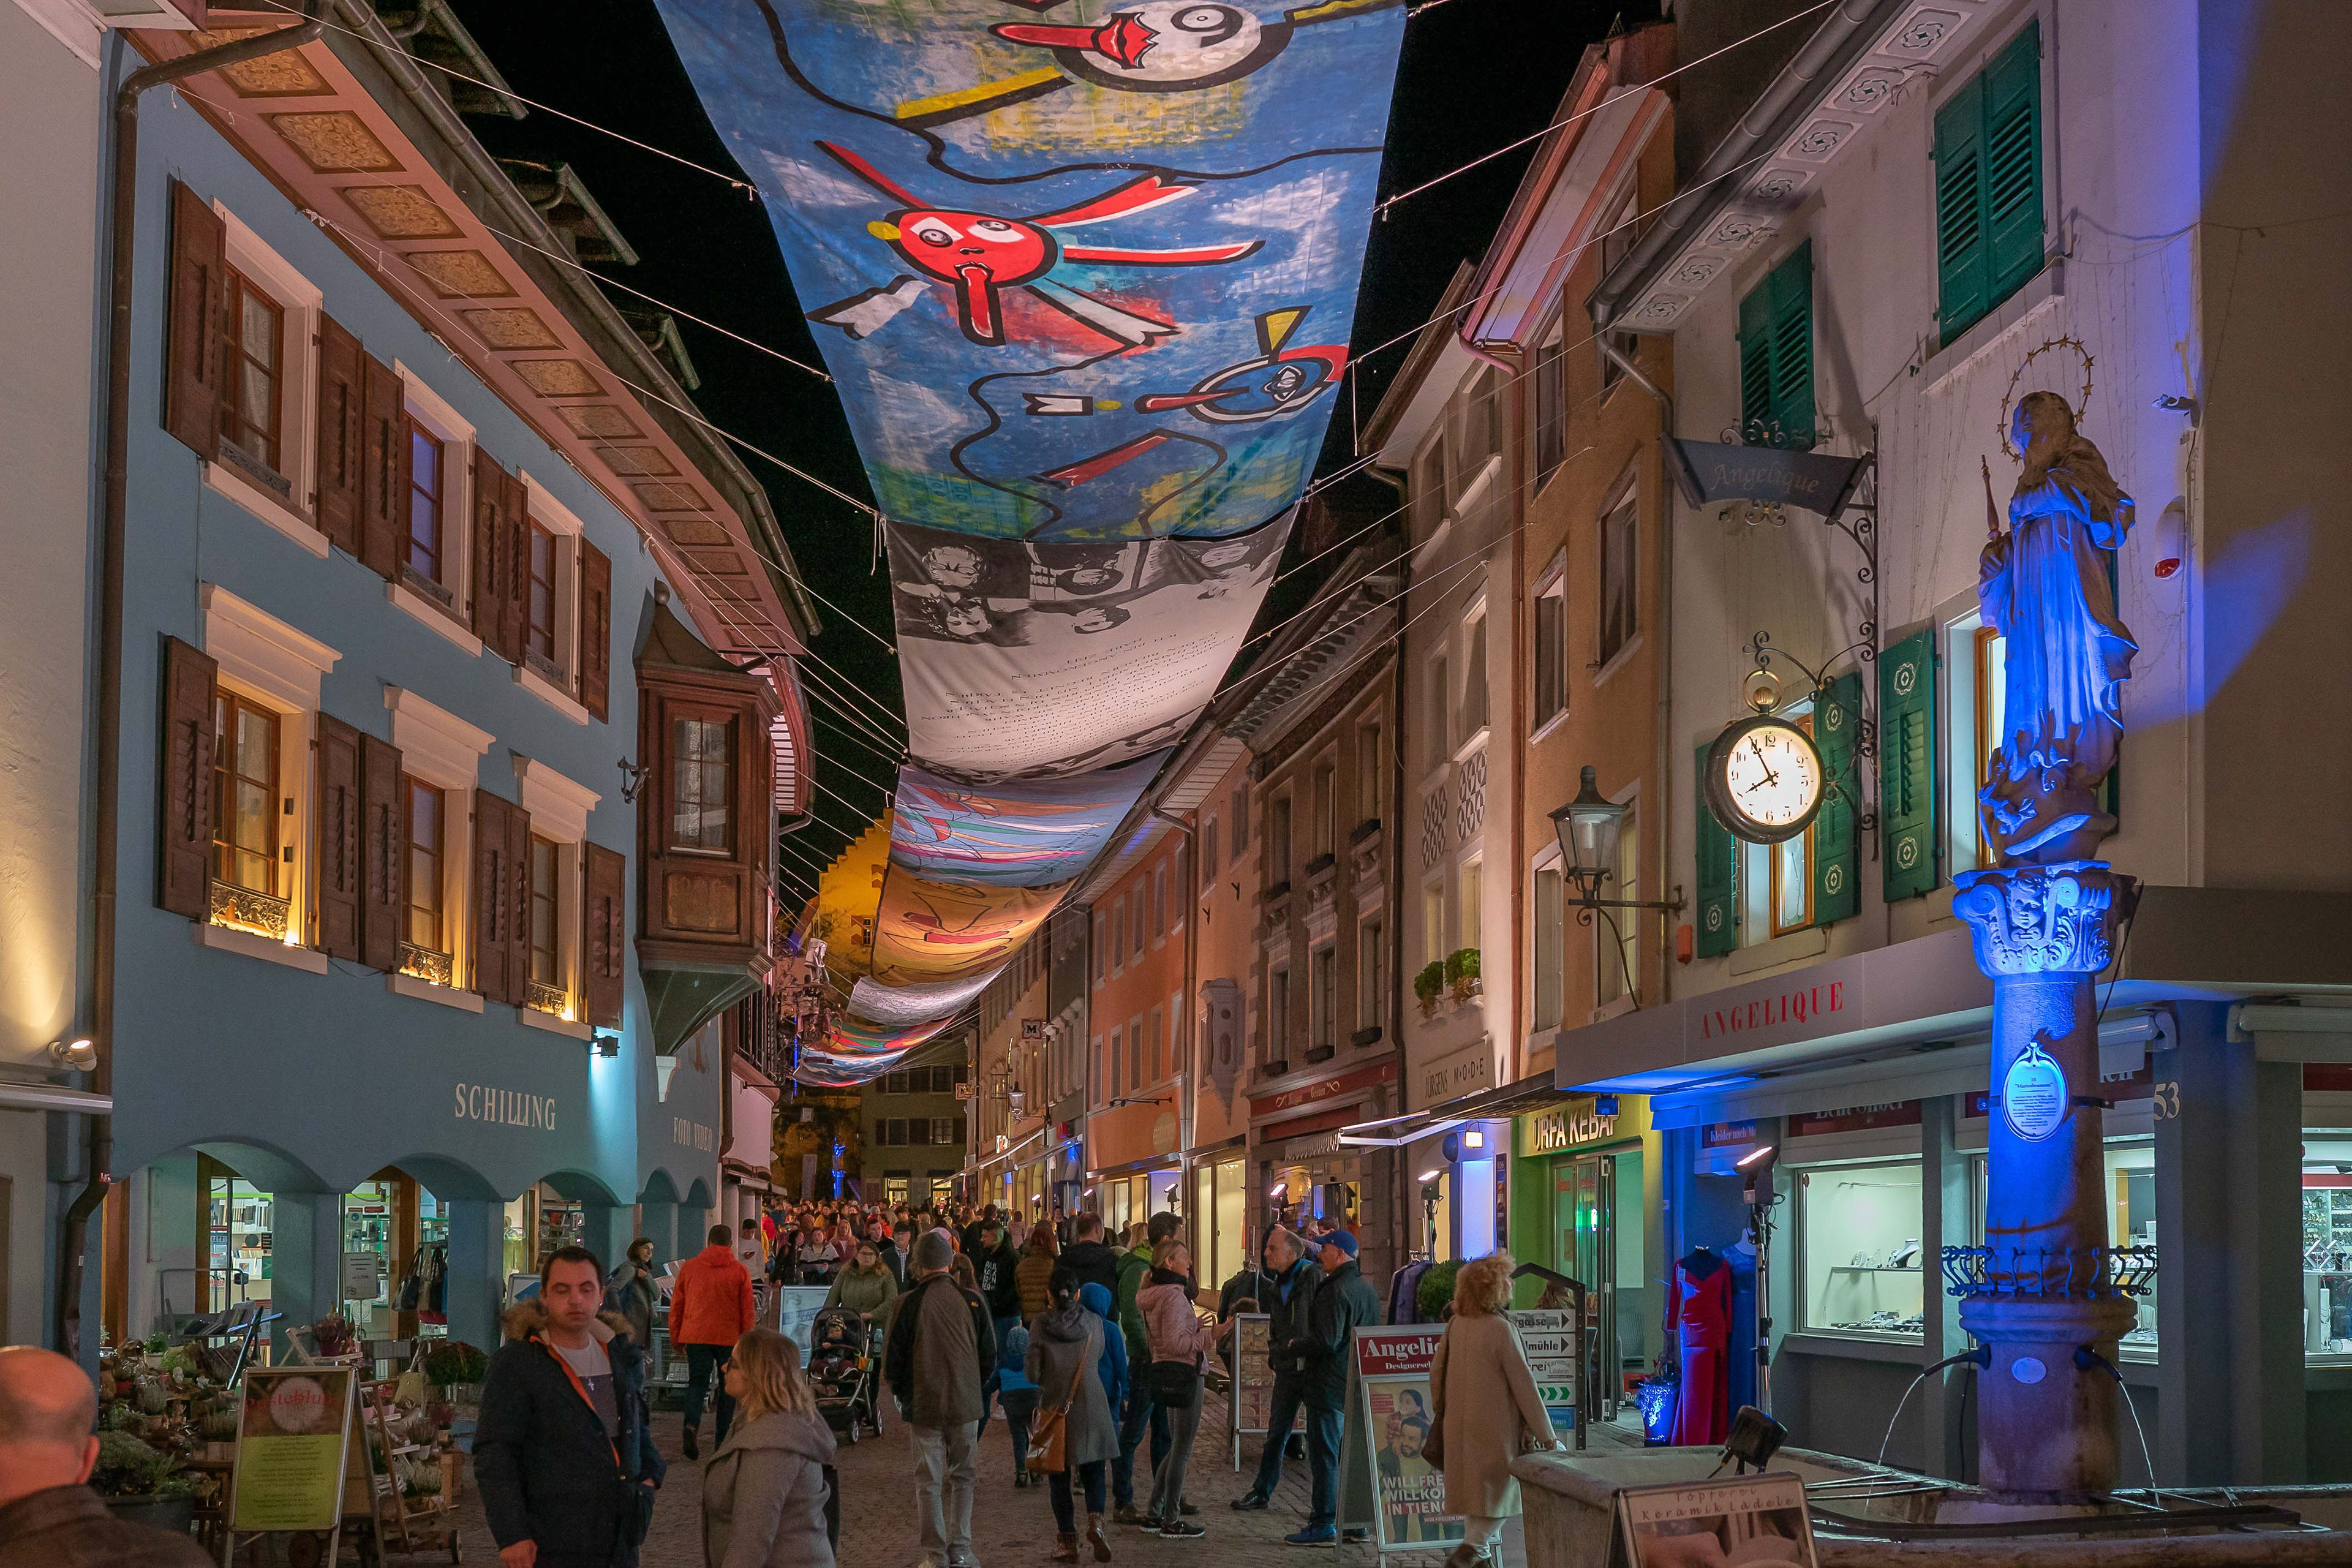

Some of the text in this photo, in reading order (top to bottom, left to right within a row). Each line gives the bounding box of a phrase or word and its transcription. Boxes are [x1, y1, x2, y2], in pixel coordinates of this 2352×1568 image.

[1711, 463, 1820, 495] Angelique
[1765, 735, 1776, 747] 12
[1787, 741, 1790, 754] 1
[1736, 751, 1746, 763] 10
[1796, 755, 1804, 768] 2
[1732, 769, 1739, 781] 9
[1801, 774, 1809, 787] 3
[1766, 809, 1774, 822] 6
[1783, 805, 1792, 818] 5
[1703, 981, 1843, 1039] ANGELIQUE
[1425, 1069, 1448, 1099] JÜRGENS
[454, 1082, 556, 1131] SCHILLING
[2154, 1081, 2180, 1121] 53
[674, 1117, 712, 1152] FOTO VIDEO
[1533, 1110, 1566, 1150] URFA
[1515, 1318, 1546, 1329] gasse
[1530, 1361, 1547, 1372] rei
[1386, 1502, 1403, 1515] IN
[1642, 1501, 1724, 1521] Keramik
